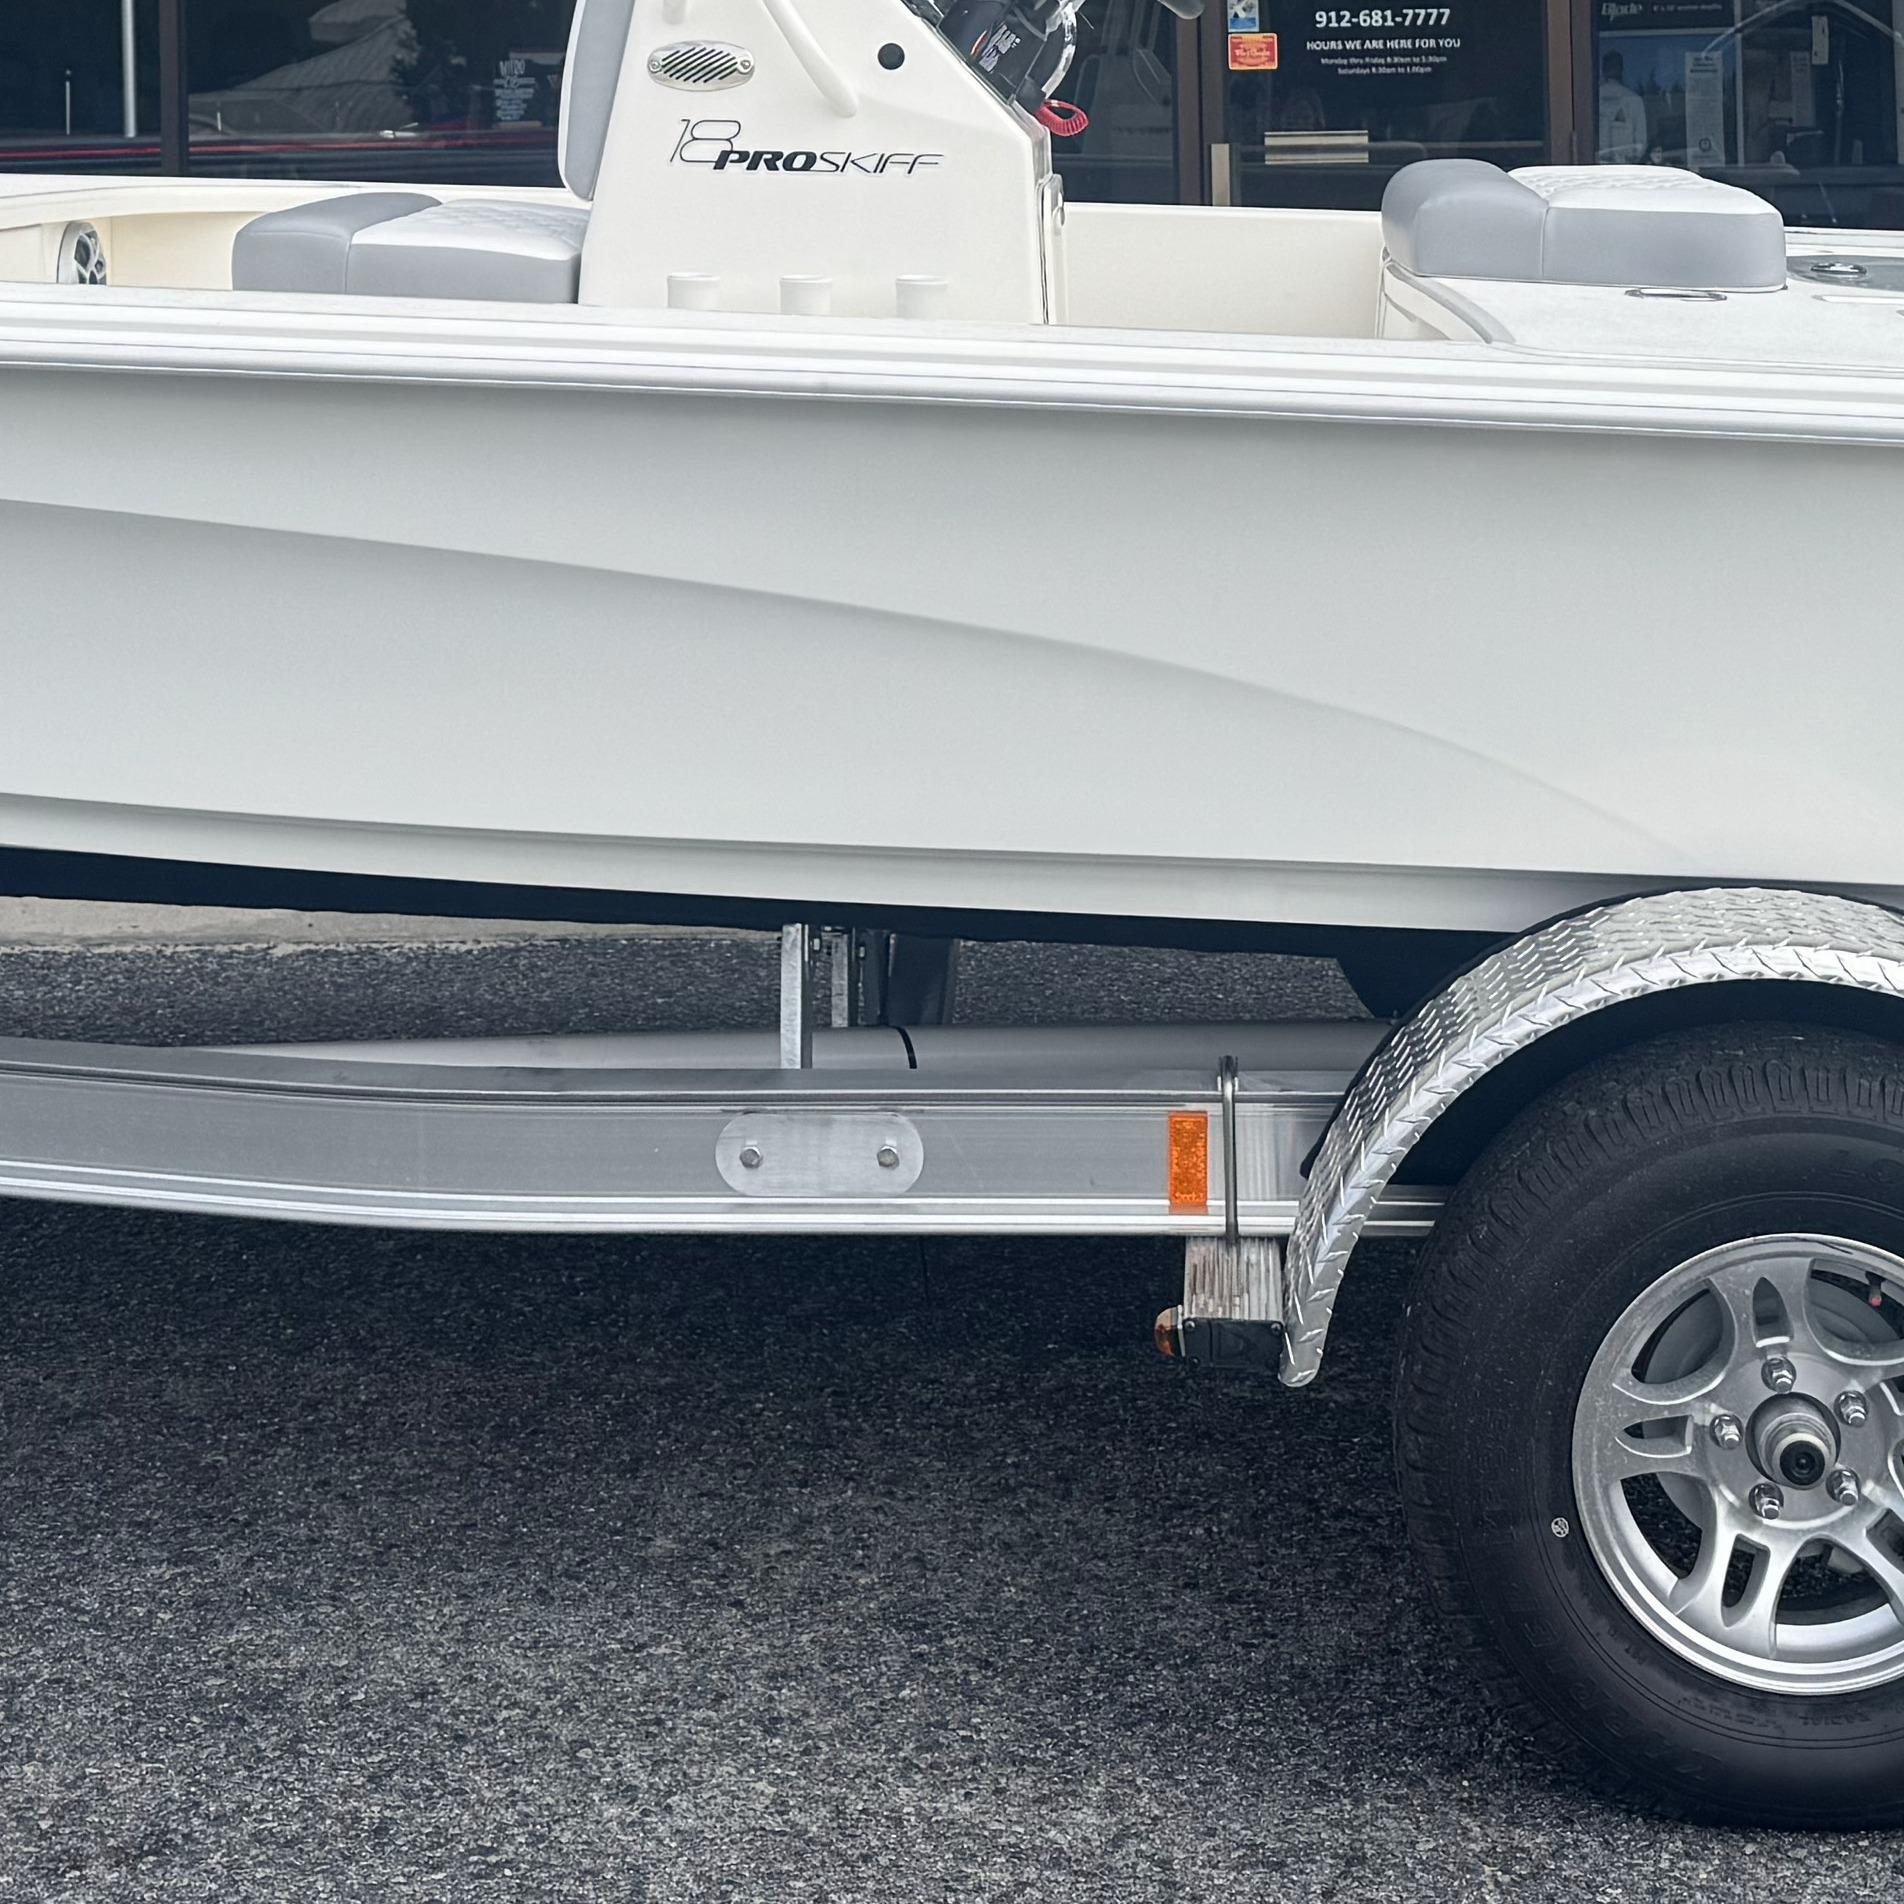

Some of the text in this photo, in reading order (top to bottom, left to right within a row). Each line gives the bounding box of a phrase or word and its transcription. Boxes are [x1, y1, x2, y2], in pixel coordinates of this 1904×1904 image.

[1315, 8, 1450, 28] 912-681-7777
[1306, 38, 1461, 50] HOURS WE ARE HERE FOR YOU
[670, 119, 742, 163] 18
